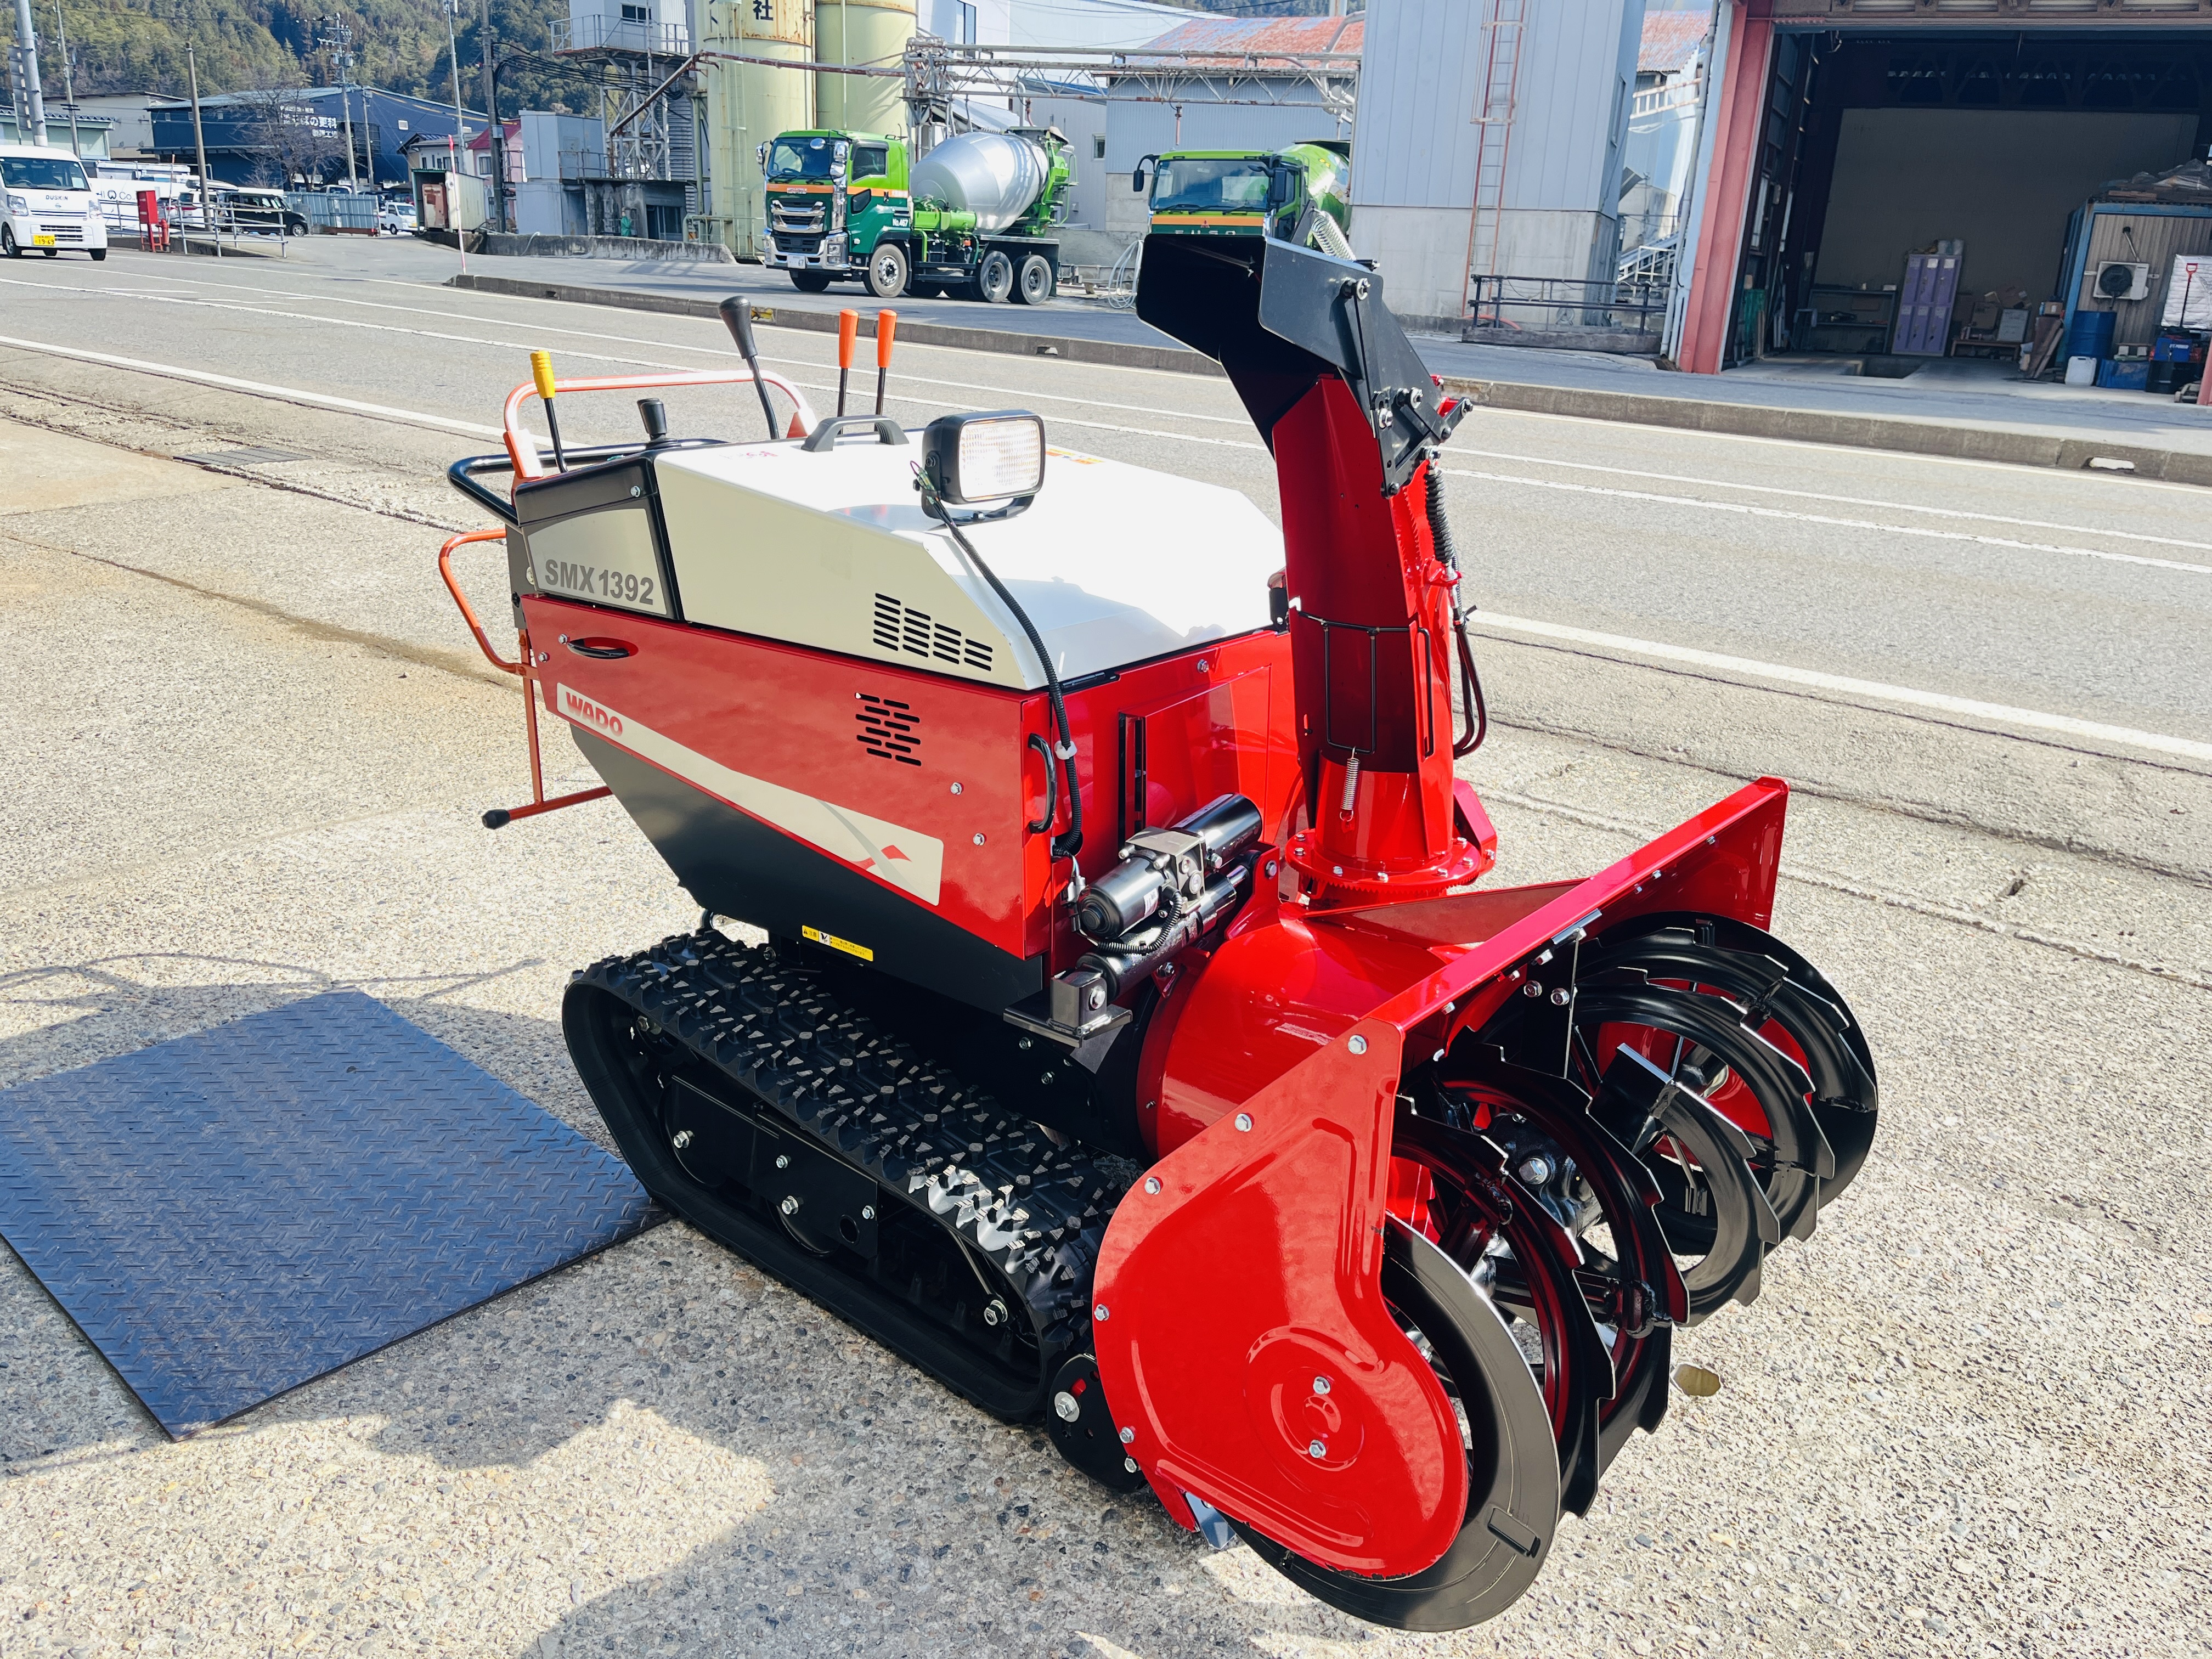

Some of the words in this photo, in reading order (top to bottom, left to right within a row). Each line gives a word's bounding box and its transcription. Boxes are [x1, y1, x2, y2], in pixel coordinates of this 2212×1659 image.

[545, 559, 595, 594] SMX
[599, 569, 654, 605] 1392
[566, 691, 623, 737] WADO
